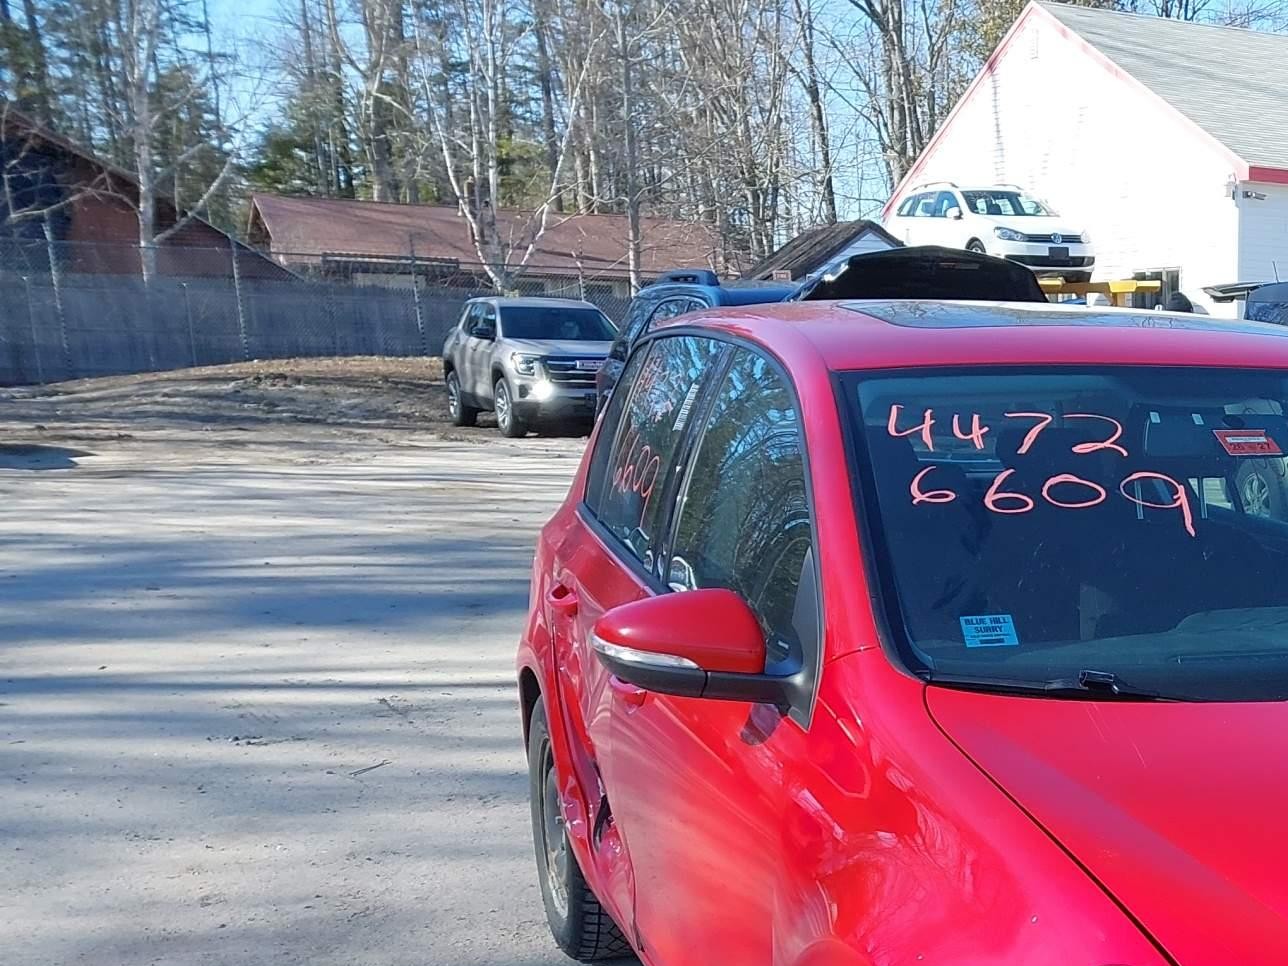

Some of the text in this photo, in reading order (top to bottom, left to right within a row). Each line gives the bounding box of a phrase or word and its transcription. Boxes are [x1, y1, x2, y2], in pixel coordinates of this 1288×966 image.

[887, 404, 1128, 457] 4472
[910, 466, 1195, 538] 6609
[965, 616, 1009, 625] BLUE HILL
